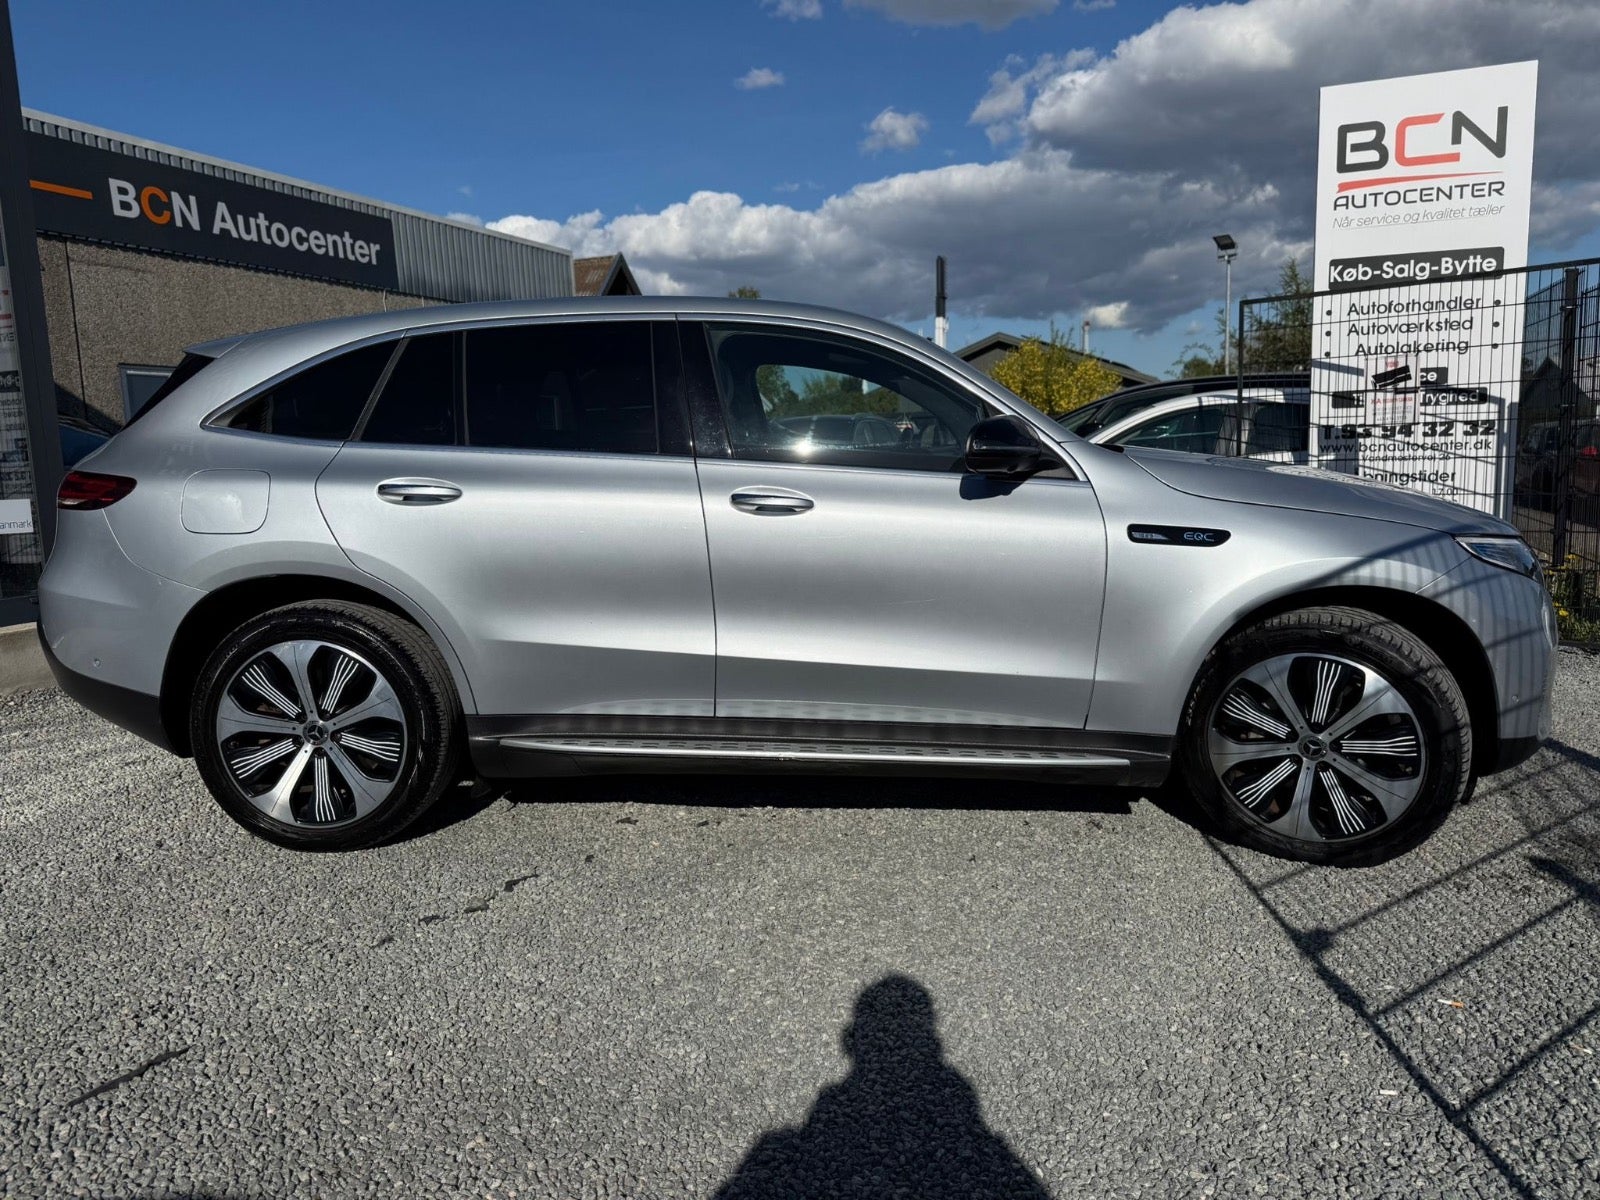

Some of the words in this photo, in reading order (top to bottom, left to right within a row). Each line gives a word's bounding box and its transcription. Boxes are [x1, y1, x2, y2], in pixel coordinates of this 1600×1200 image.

[1336, 105, 1508, 174] BCN
[1334, 181, 1505, 211] AUTOCENTER
[108, 177, 200, 231] BCN
[212, 201, 381, 265] Autocenter
[1332, 216, 1355, 229] Når
[1357, 212, 1401, 226] service
[1403, 212, 1420, 225] og
[1422, 205, 1467, 221] kvalitet
[1468, 203, 1506, 218] tæller
[1330, 254, 1497, 283] Køb-Salg-Bytte
[1347, 296, 1482, 317] Autoforhandler
[1347, 316, 1474, 337] Autoværksted
[1355, 338, 1469, 357] Autolakering
[1422, 421, 1455, 437] 32
[1463, 420, 1496, 436] 32
[1355, 470, 1456, 485] bningstider
[0, 520, 32, 530] anmark
[1184, 532, 1214, 541] EQC
